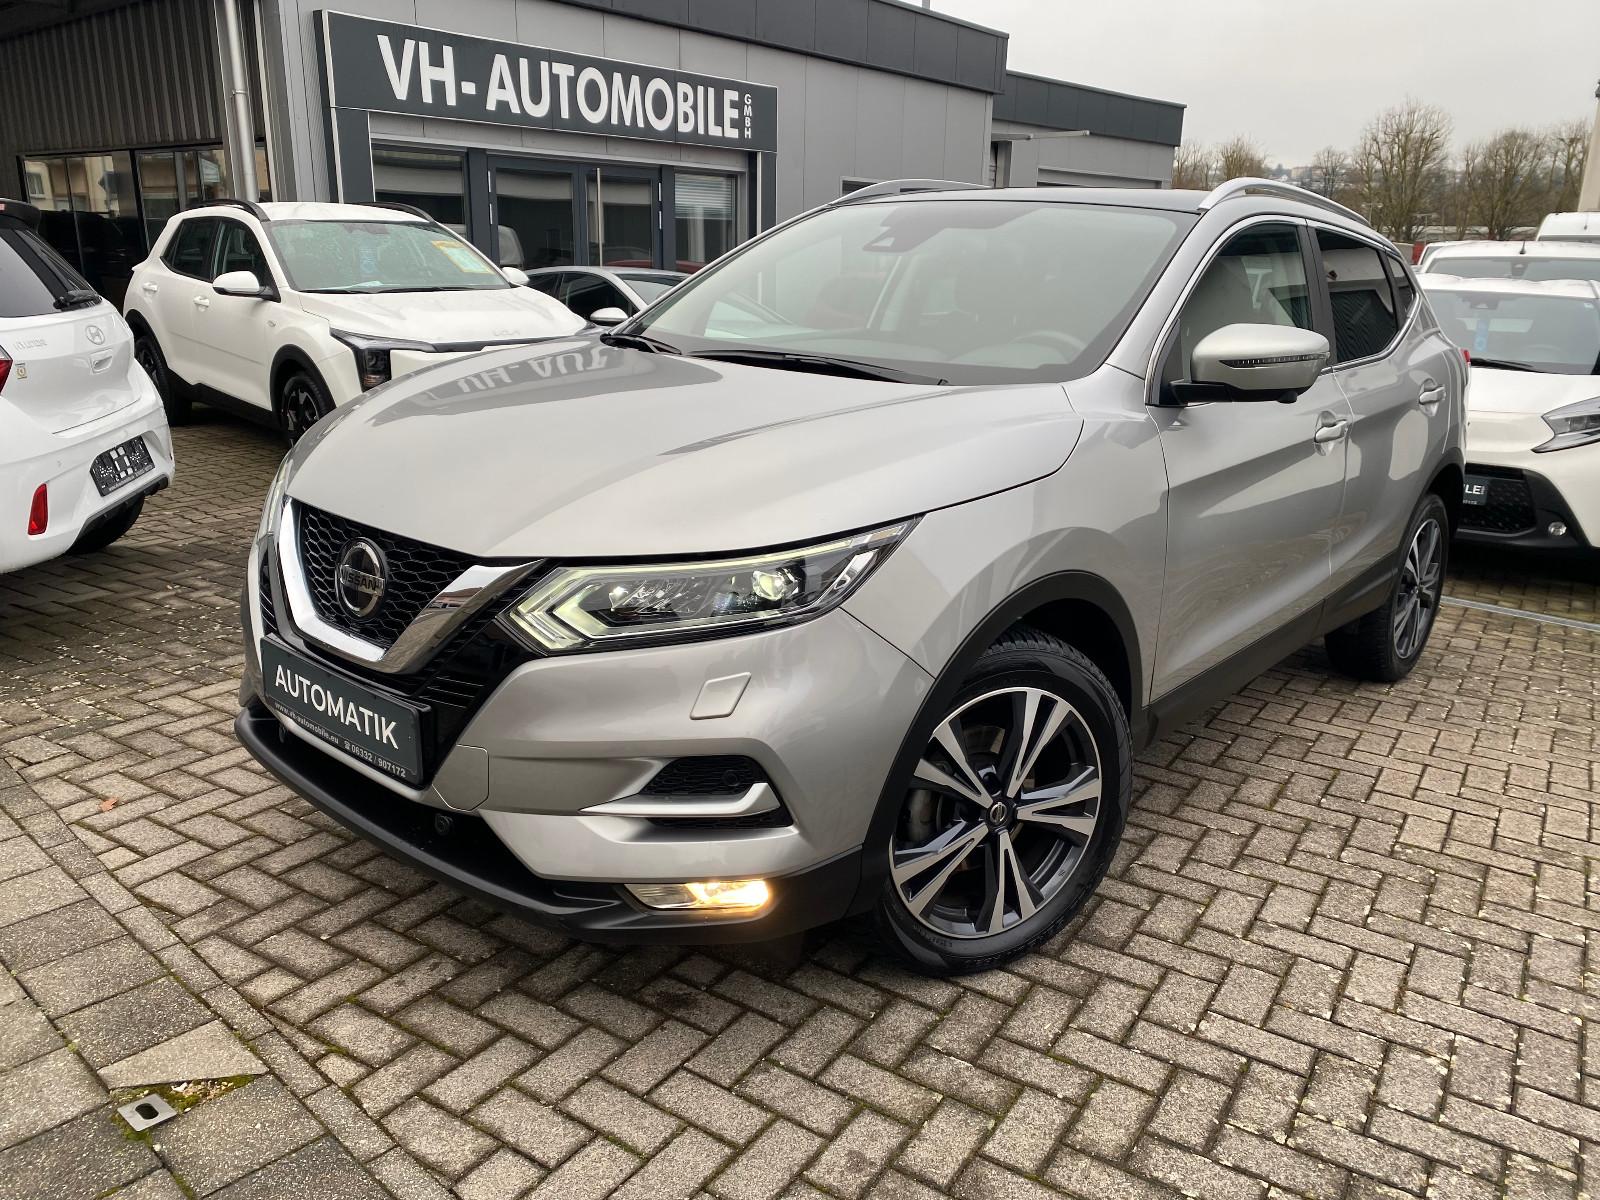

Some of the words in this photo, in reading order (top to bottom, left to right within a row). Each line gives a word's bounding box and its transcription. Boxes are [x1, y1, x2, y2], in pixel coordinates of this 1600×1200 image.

[377, 34, 476, 106] VH-
[485, 53, 740, 139] AUTOMOBILE
[743, 93, 753, 139] GMBH
[341, 567, 381, 591] NISSAN
[275, 664, 399, 750] AUTOMATIK
[351, 744, 373, 762] 06332
[377, 757, 406, 778] 907172
